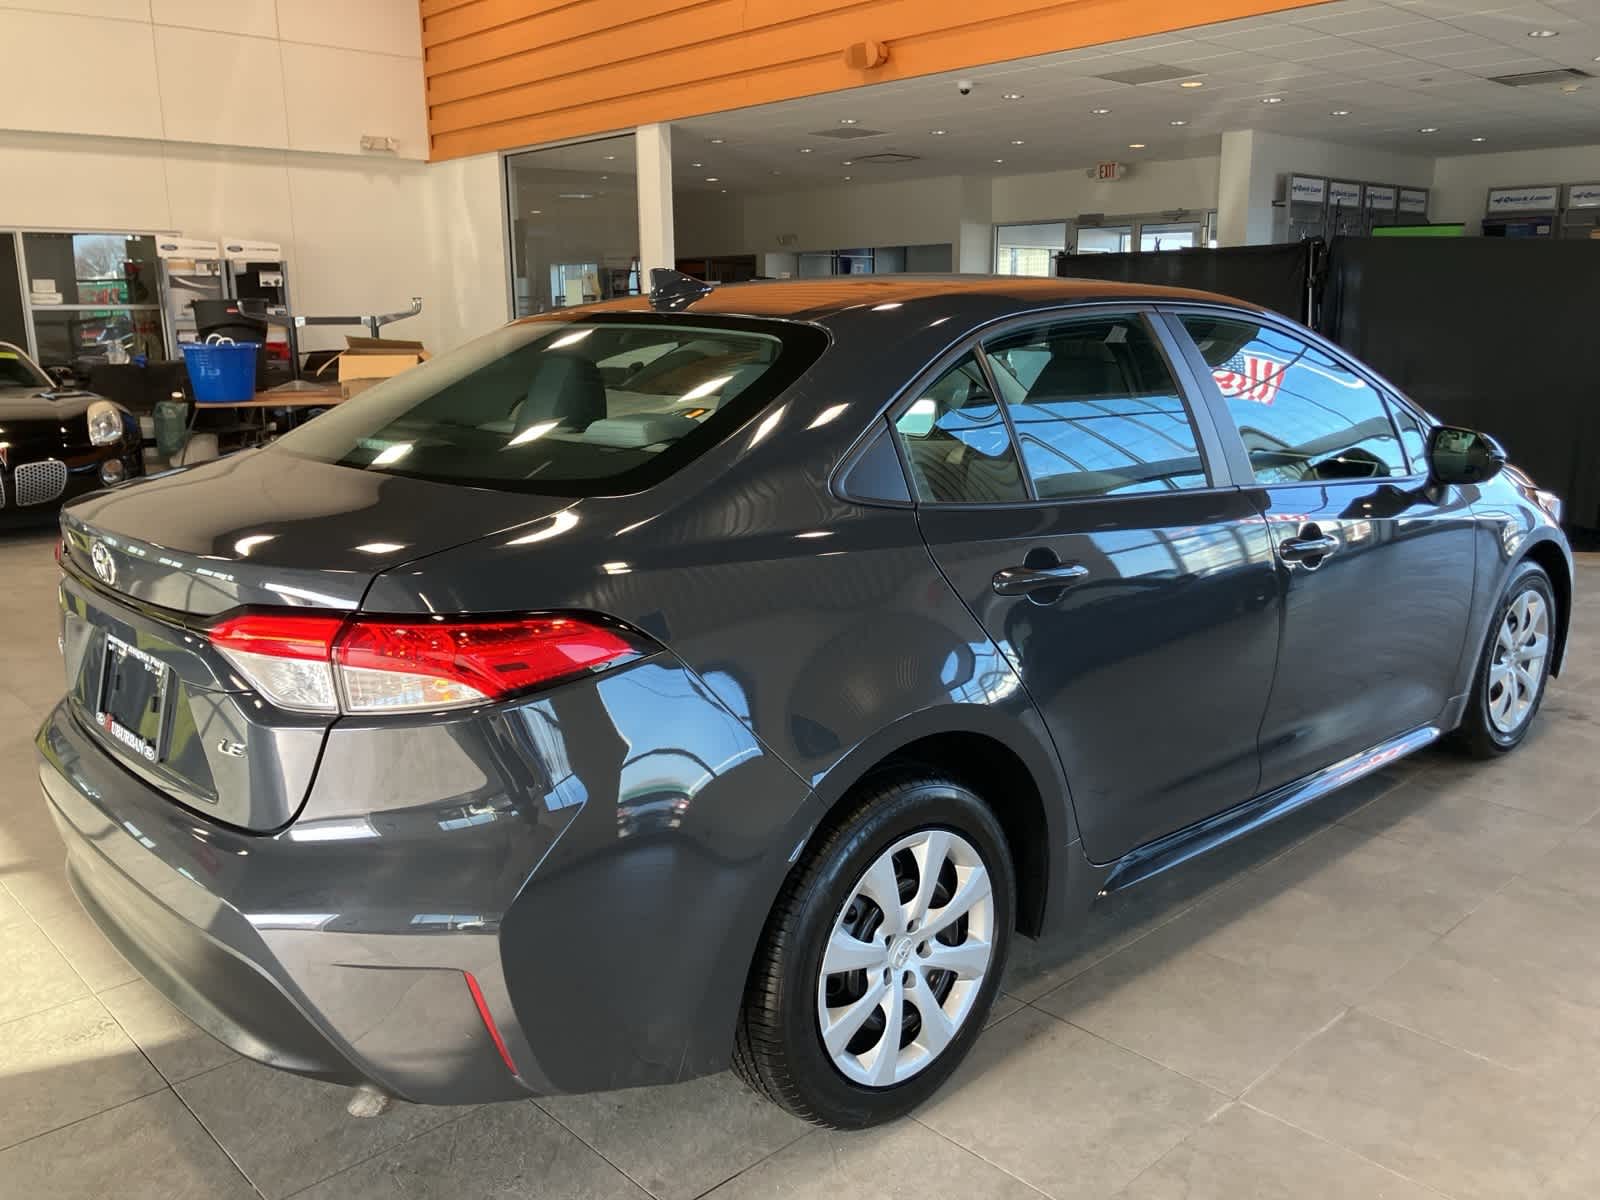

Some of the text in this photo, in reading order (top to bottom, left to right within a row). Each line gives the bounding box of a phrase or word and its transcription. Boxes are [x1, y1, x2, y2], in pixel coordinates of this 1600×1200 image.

[1099, 163, 1116, 179] EXIT
[104, 712, 145, 755] SUBURBAN
[217, 737, 247, 758] LE
